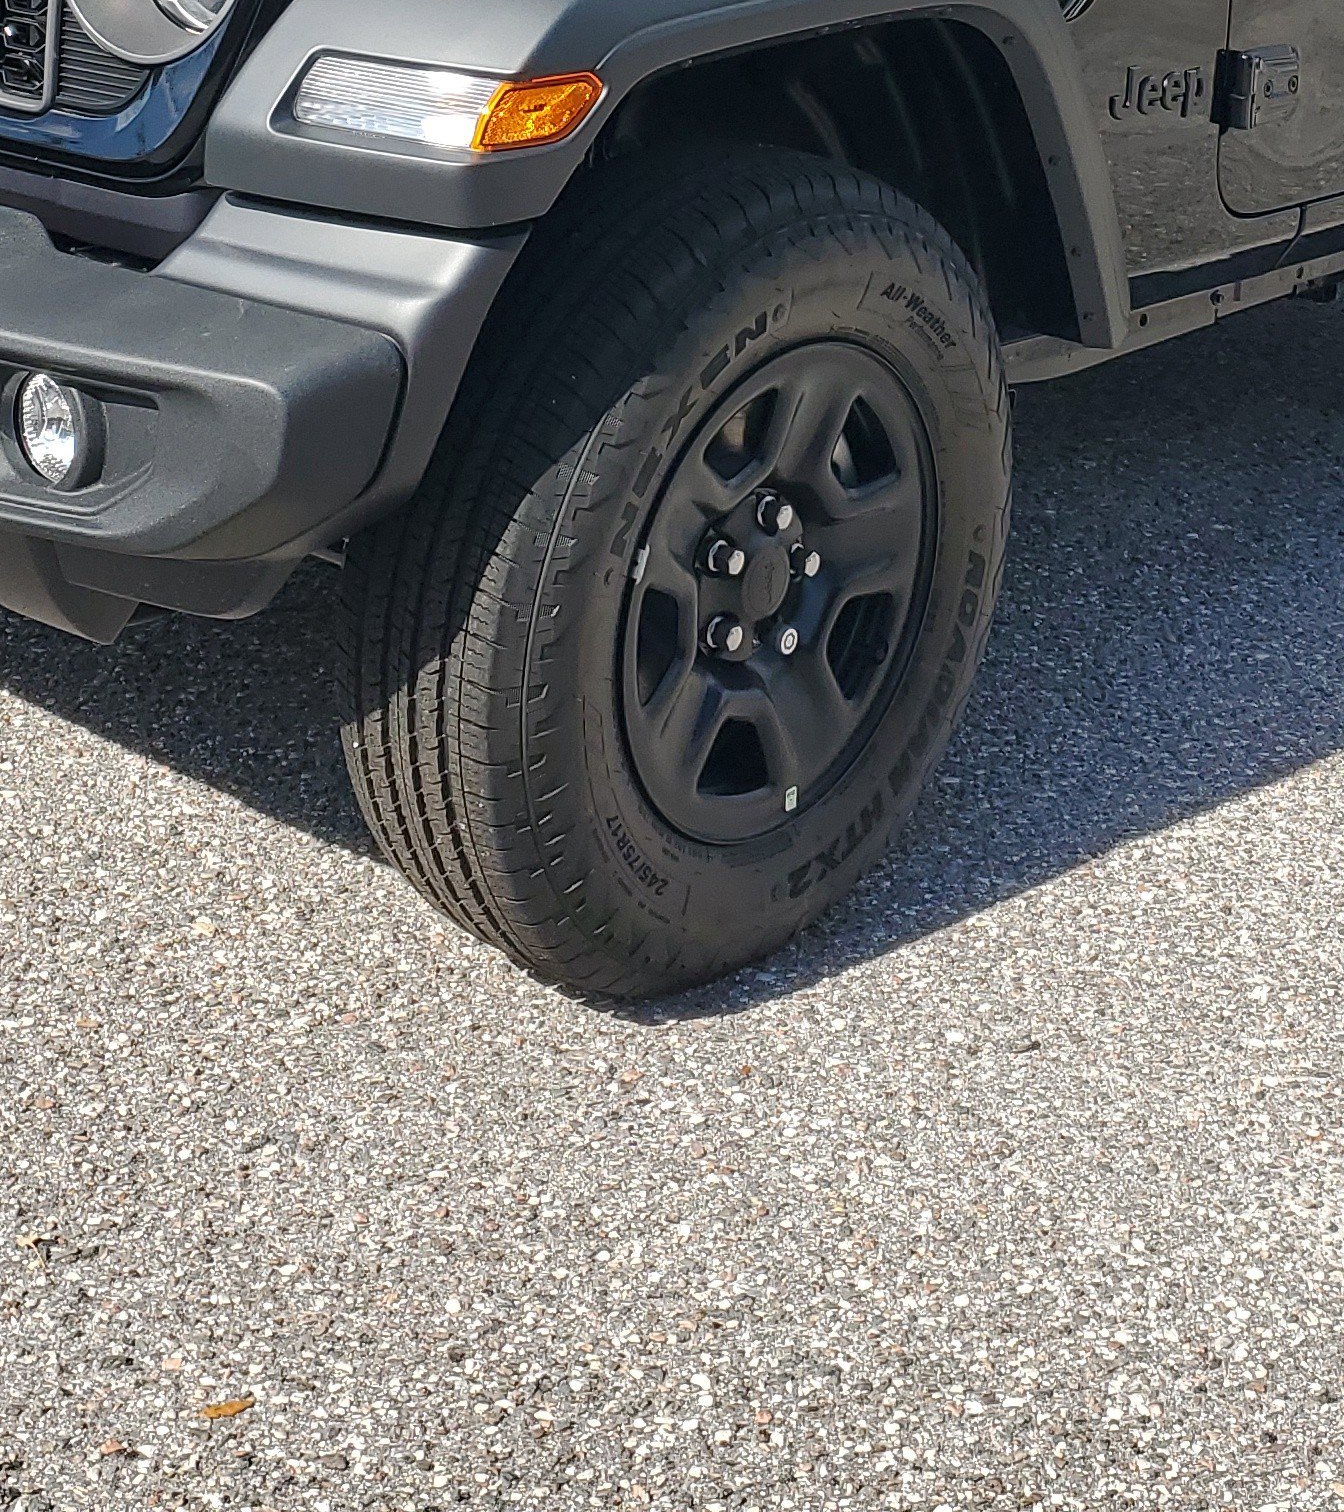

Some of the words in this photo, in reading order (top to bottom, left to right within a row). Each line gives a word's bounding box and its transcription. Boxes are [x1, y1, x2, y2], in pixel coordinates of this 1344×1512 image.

[1109, 65, 1205, 121] Jeep
[880, 282, 957, 349] All-Weather
[610, 311, 767, 558] NEXEN
[606, 816, 669, 896] 245/75R17
